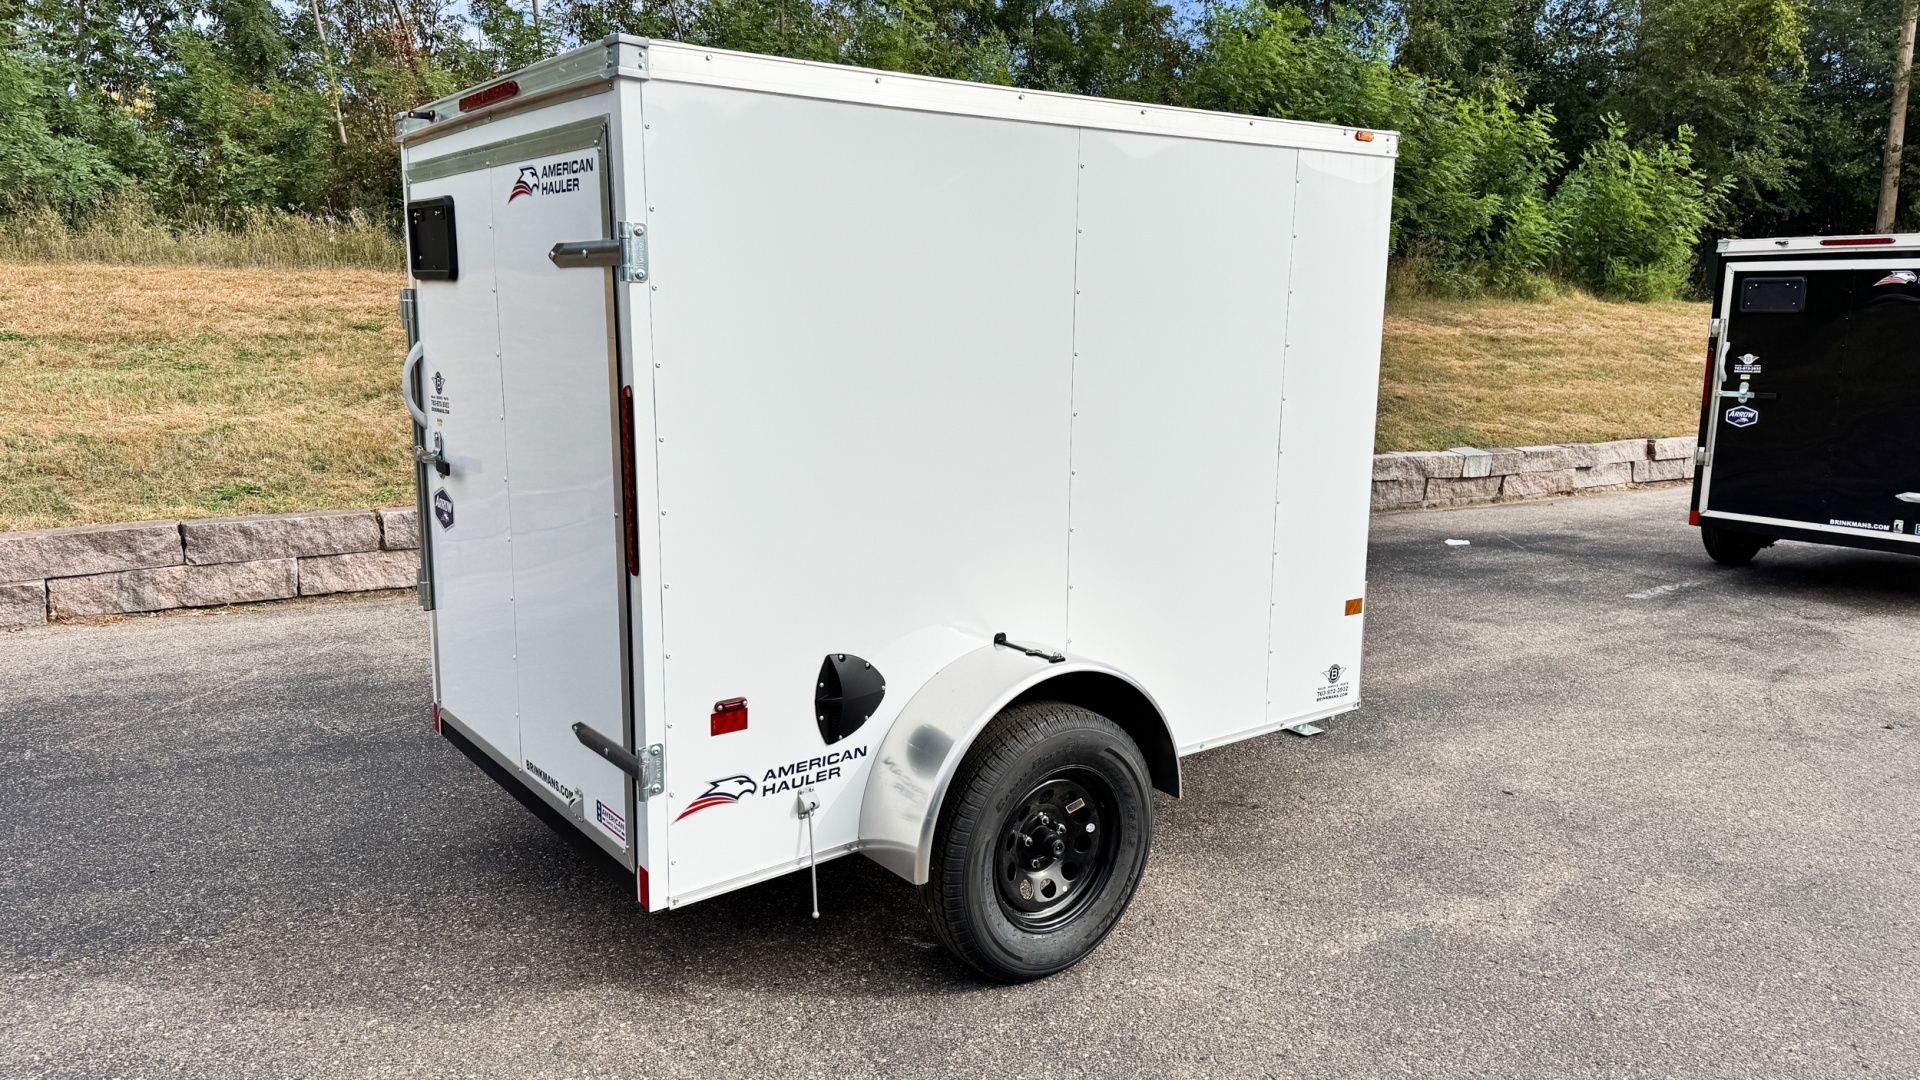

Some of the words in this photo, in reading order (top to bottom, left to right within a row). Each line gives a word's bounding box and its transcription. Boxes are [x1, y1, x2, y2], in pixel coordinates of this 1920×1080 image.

[541, 158, 594, 179] AMERICAN
[541, 178, 580, 196] HAULER
[1728, 410, 1756, 418] ARROW
[1829, 519, 1890, 531] BRINKMANS.COM
[762, 746, 868, 782] AMERICAN
[526, 759, 574, 800] BRINKMANS.COM
[762, 767, 841, 797] HAULER
[602, 808, 625, 831] AMERICAN
